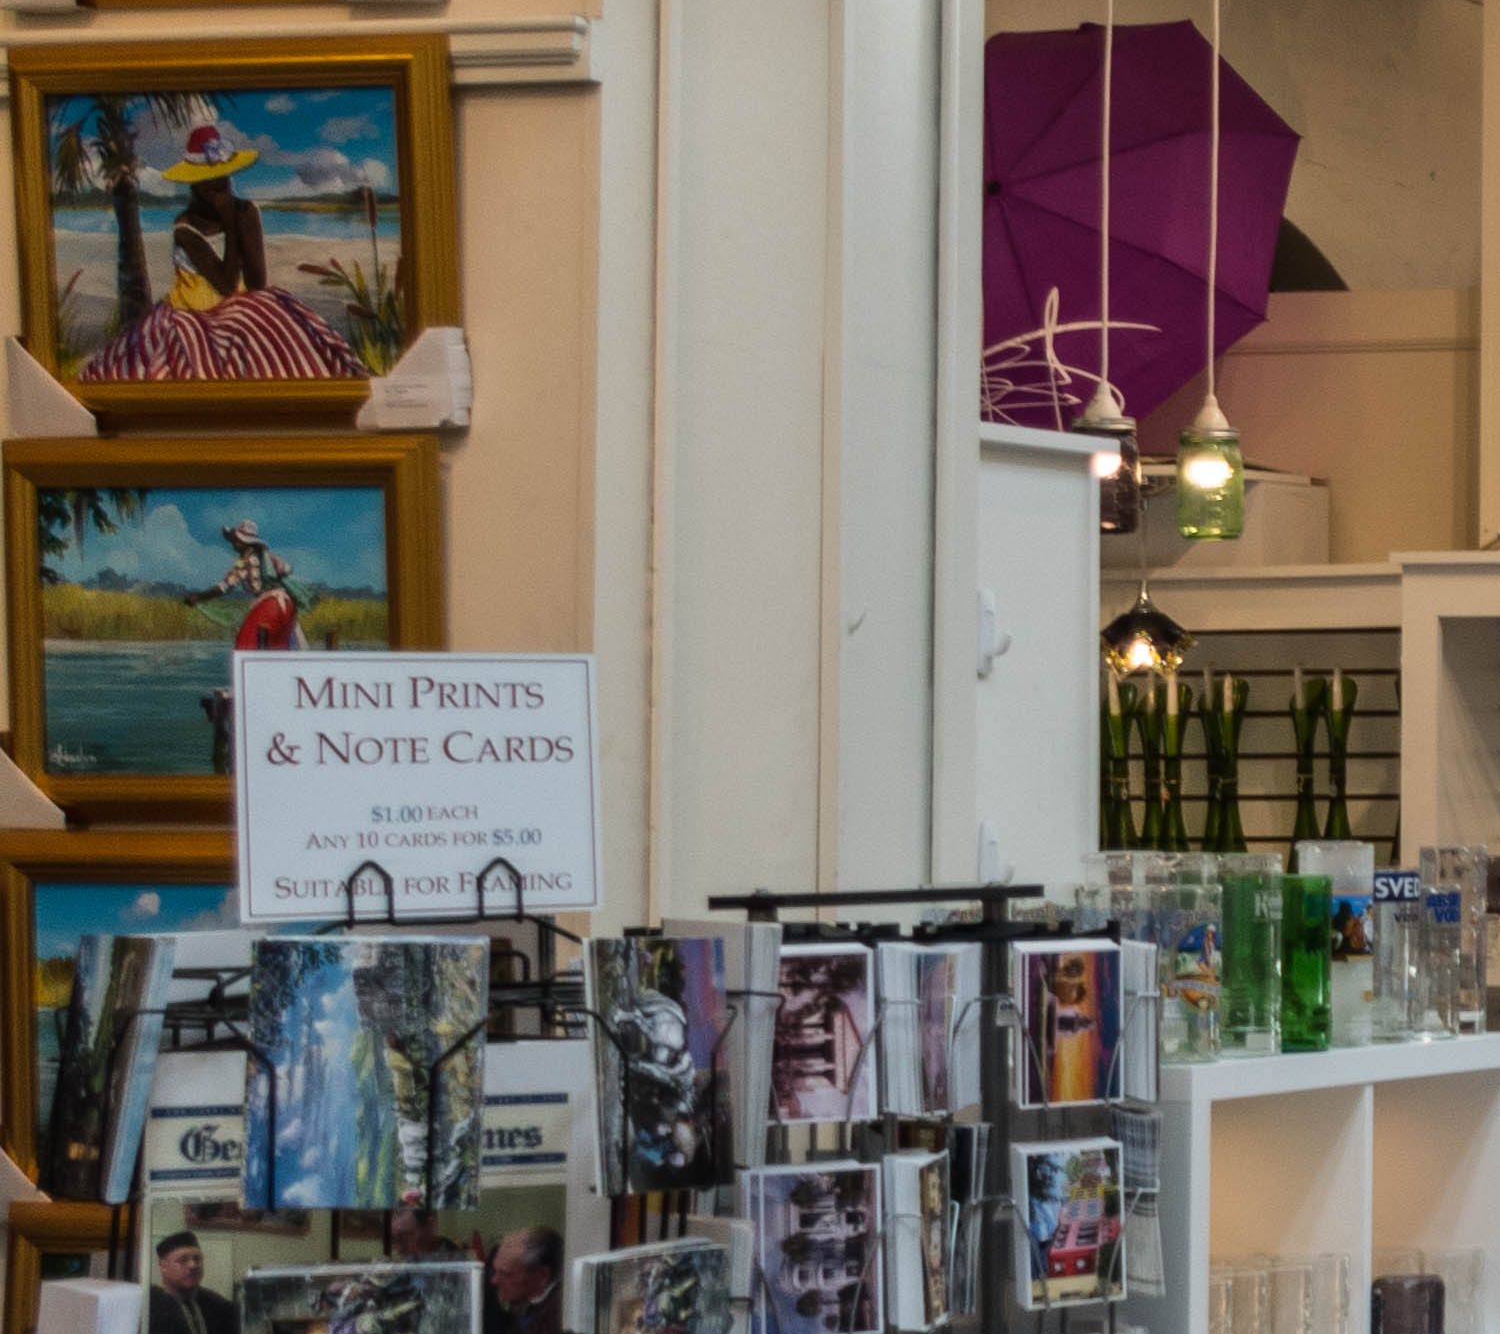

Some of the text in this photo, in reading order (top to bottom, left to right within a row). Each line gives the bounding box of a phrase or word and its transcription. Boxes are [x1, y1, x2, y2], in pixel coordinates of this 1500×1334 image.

[266, 731, 302, 766] &
[371, 805, 424, 824] $1.00
[356, 830, 379, 849] 10
[491, 827, 543, 847] $5.00
[275, 876, 392, 900] SUITABL
